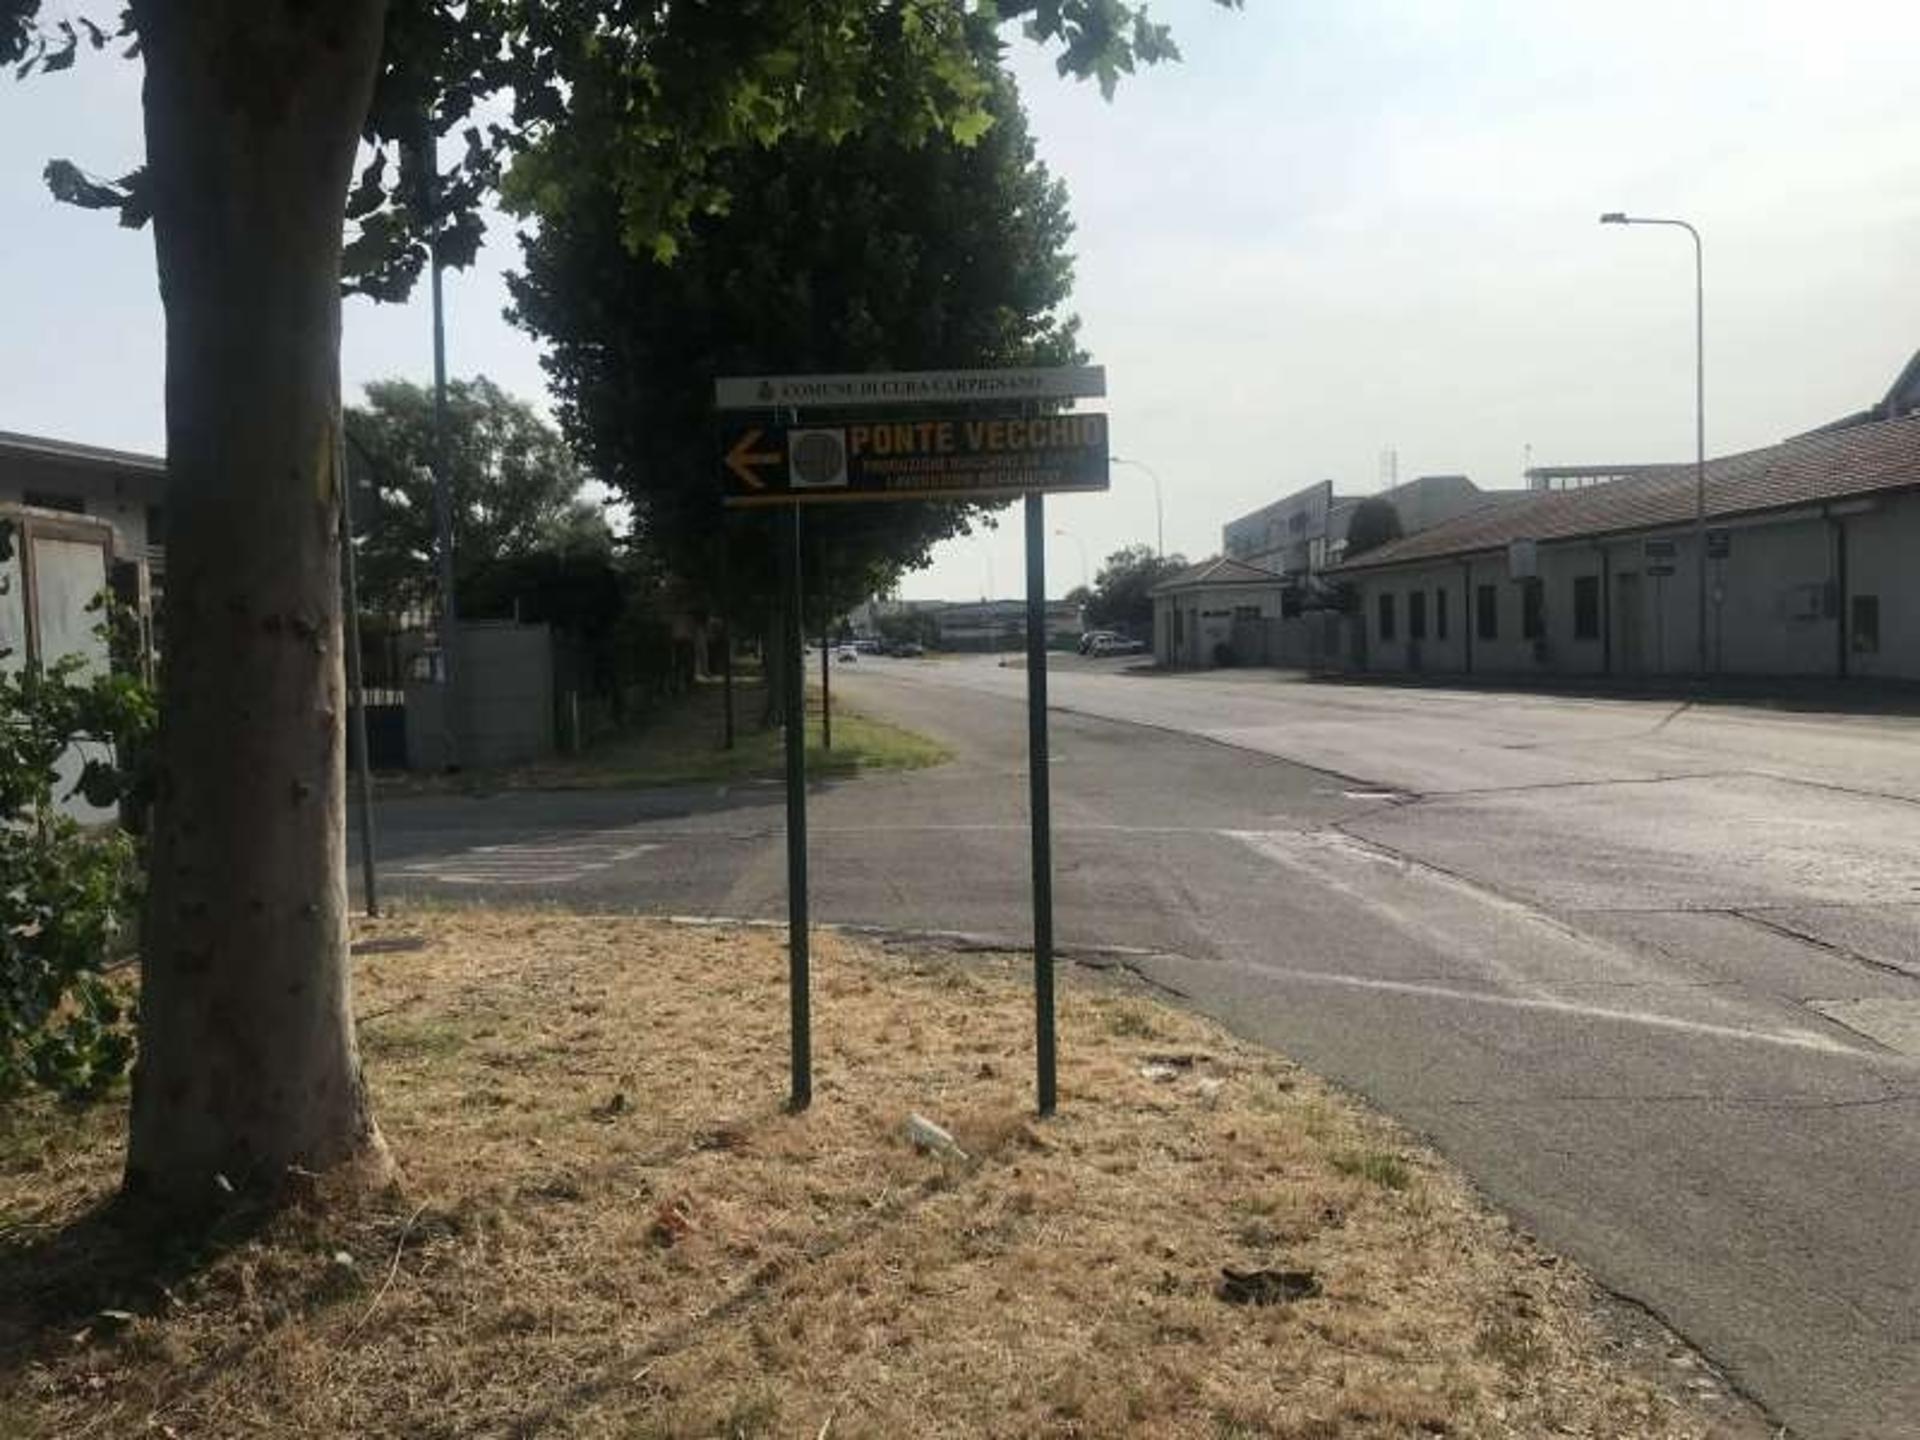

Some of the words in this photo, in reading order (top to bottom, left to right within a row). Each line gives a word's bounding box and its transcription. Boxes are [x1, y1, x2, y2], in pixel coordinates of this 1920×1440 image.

[782, 381, 859, 397] COMUNE
[861, 380, 877, 396] DI
[850, 422, 954, 455] PONTE
[965, 416, 1103, 450] VECCHIO
